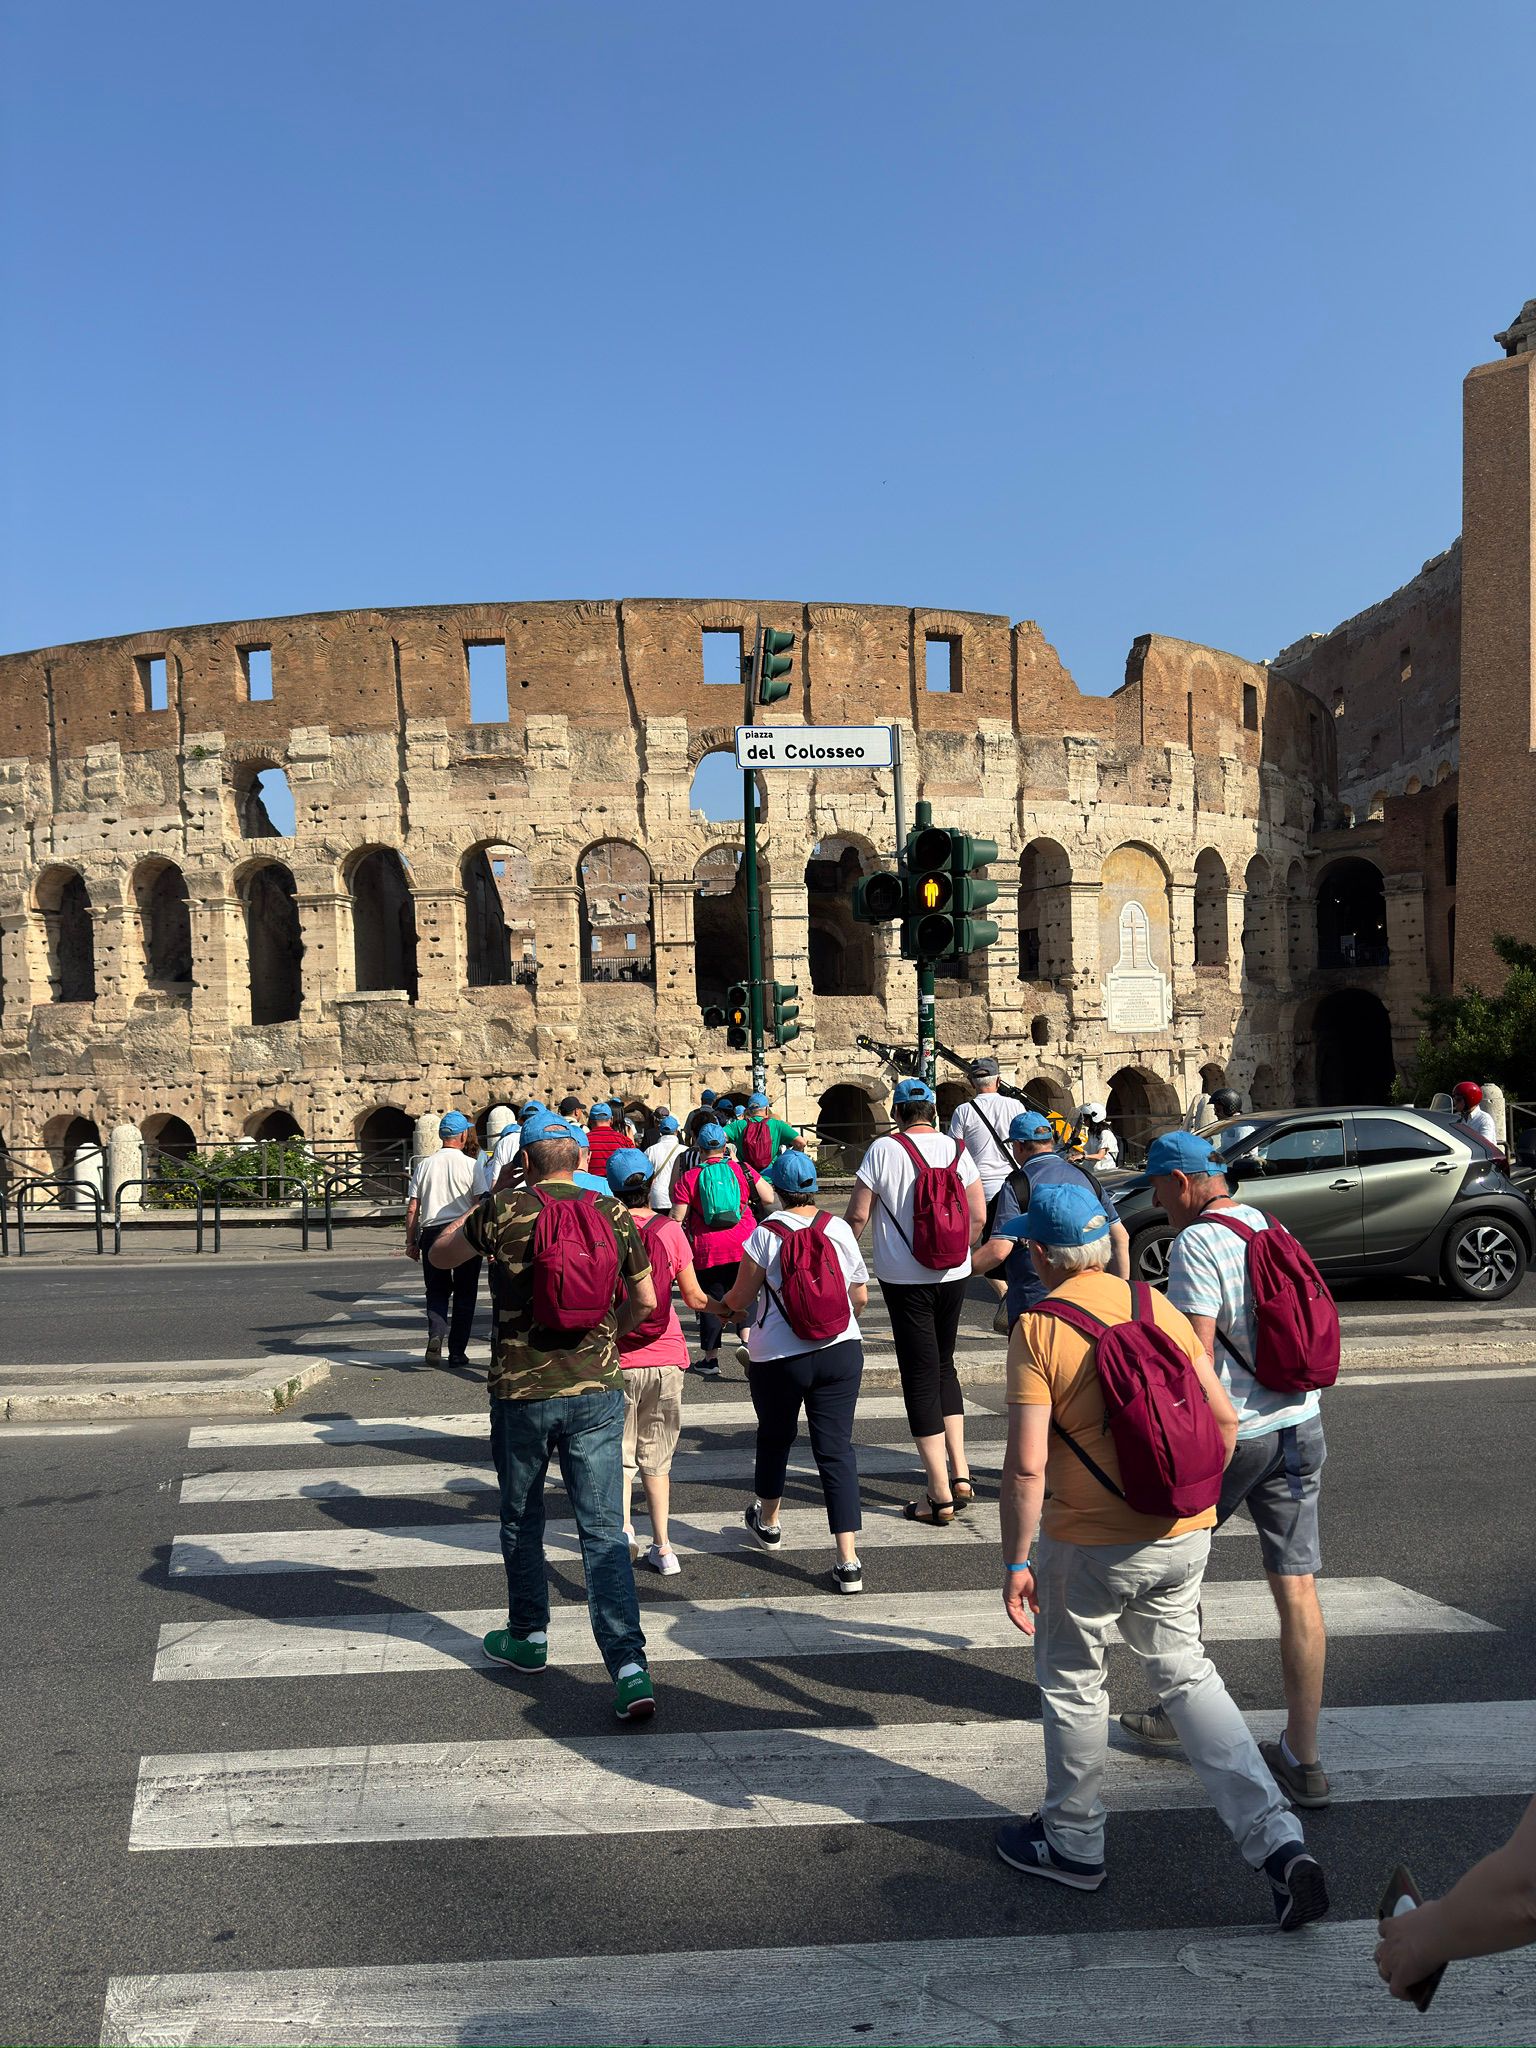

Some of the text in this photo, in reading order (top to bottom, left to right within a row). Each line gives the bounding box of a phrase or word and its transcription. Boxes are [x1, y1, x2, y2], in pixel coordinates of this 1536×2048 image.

[745, 731, 773, 740] piazza
[747, 744, 865, 760] del Colosseo
